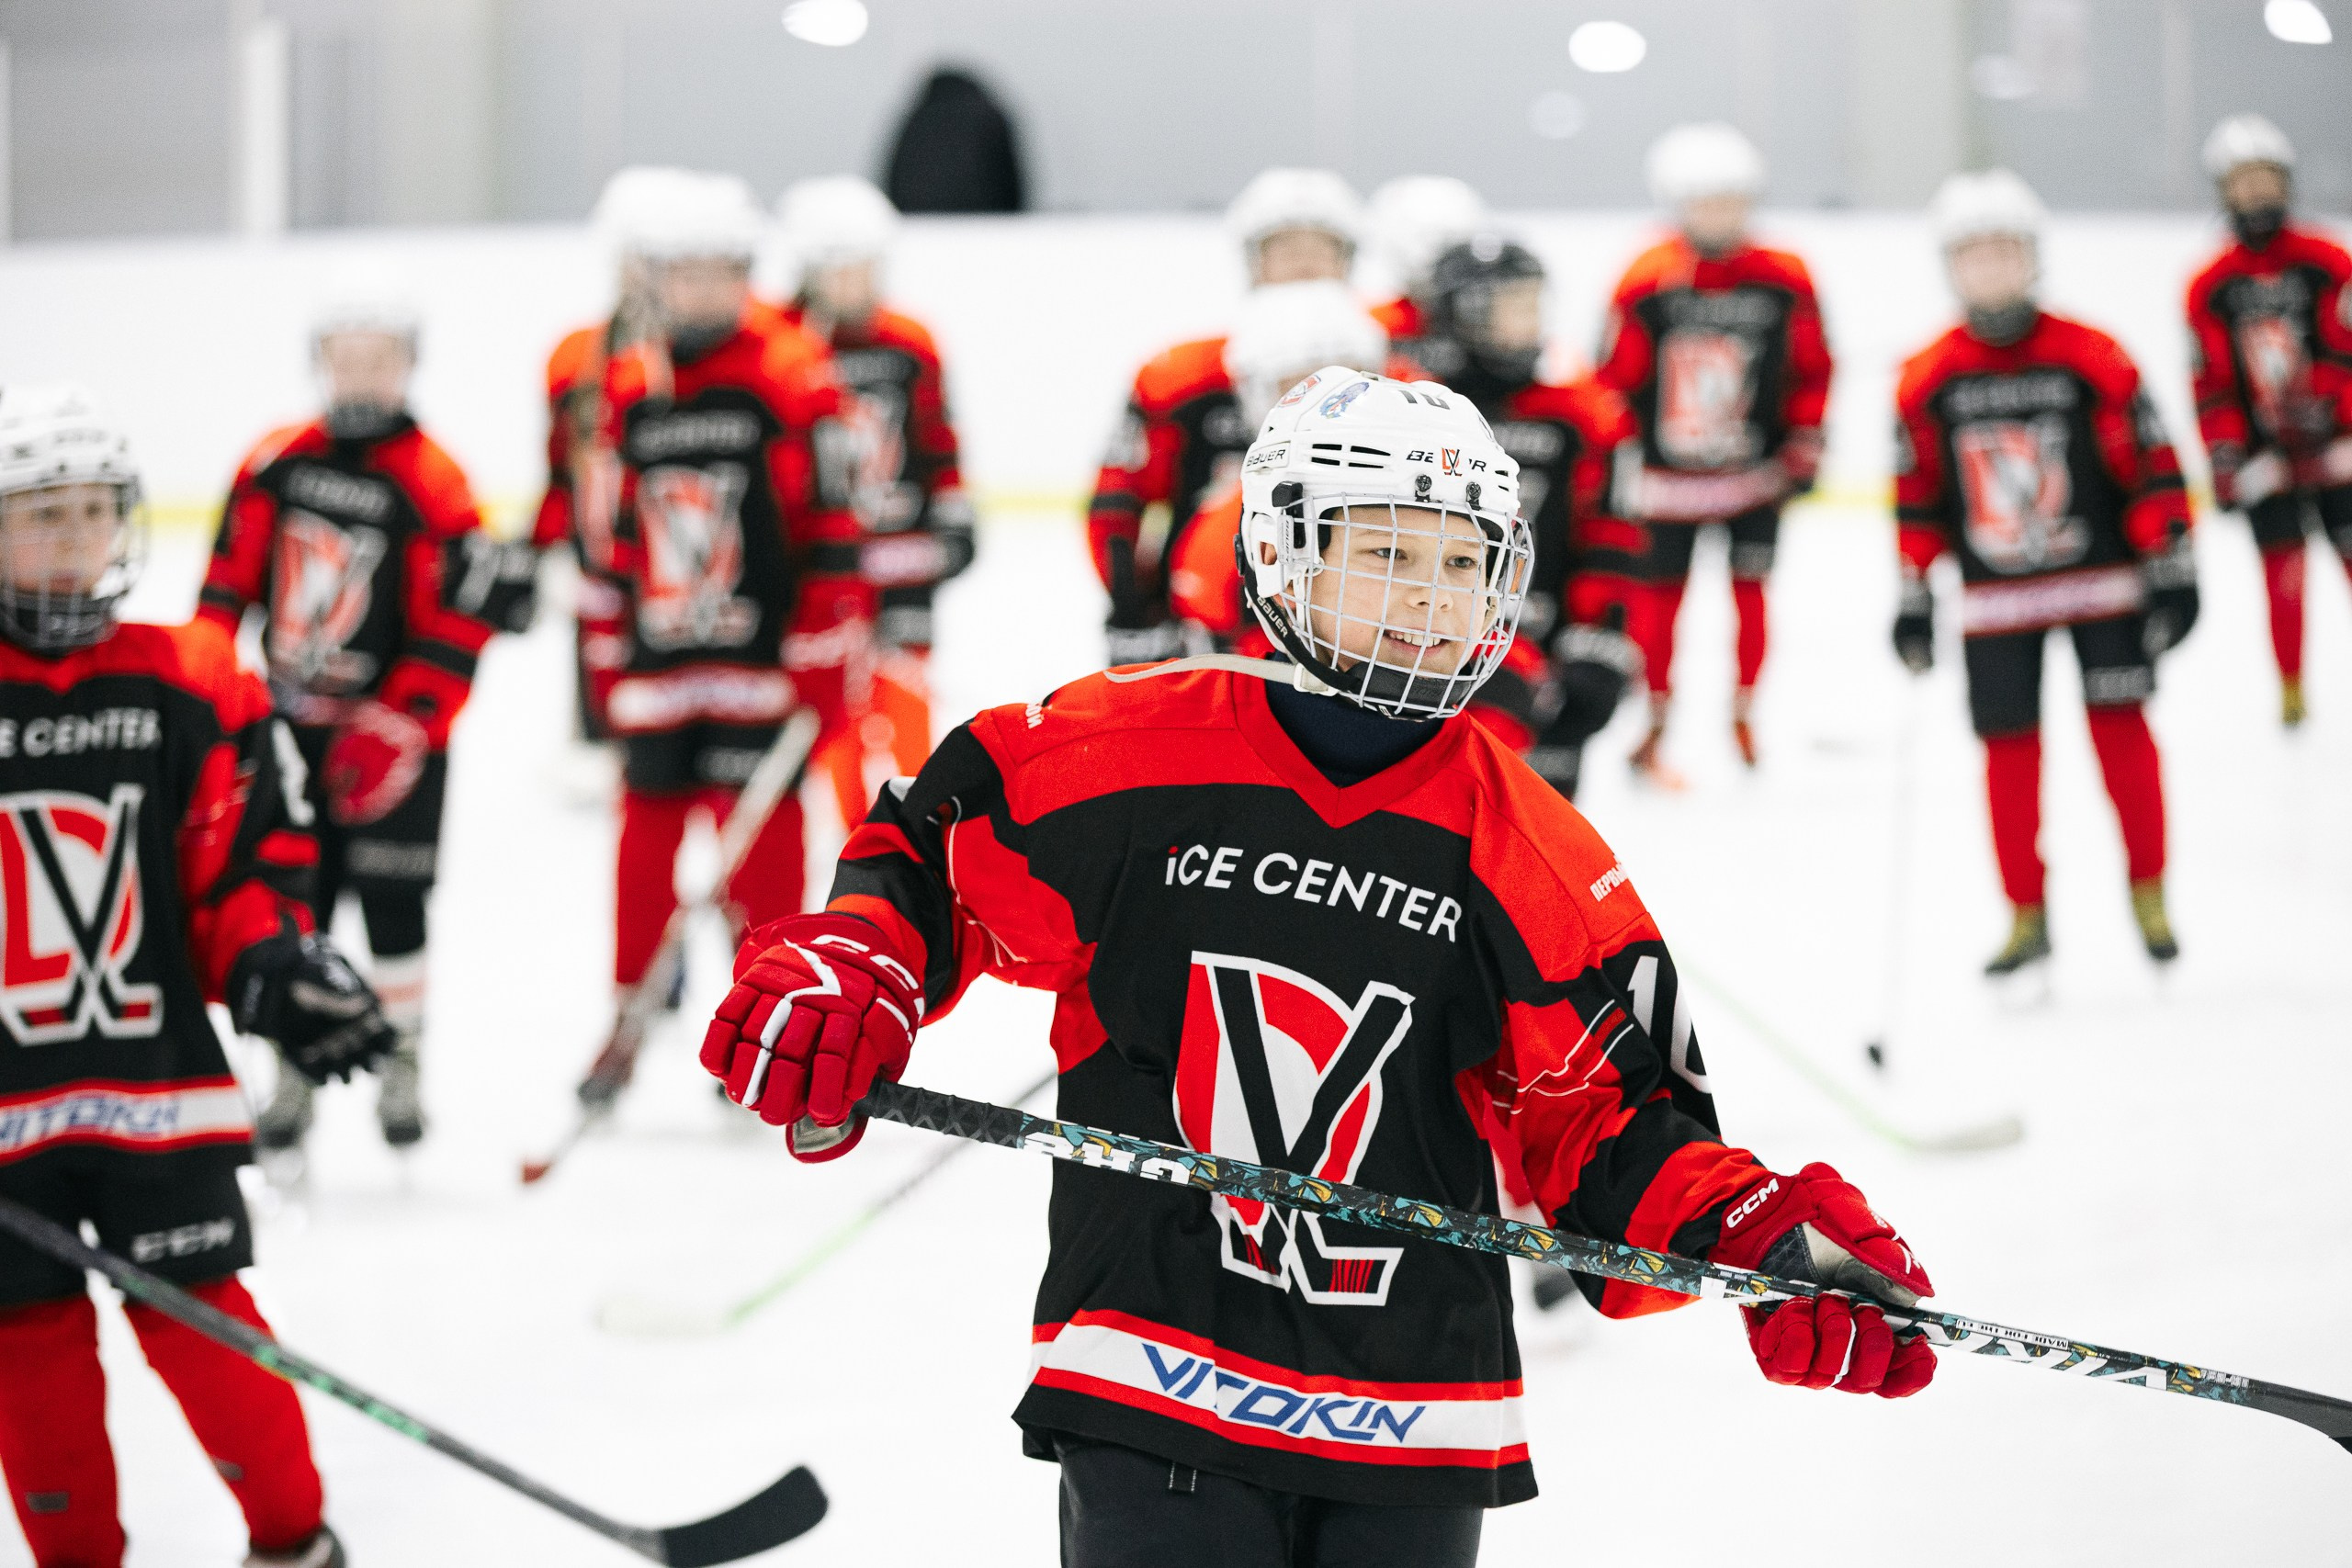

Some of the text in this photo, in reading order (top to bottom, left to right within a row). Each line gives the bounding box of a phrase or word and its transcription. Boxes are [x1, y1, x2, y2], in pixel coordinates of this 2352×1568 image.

[1247, 449, 1286, 467] BAUER
[1256, 596, 1288, 637] BAUER
[22, 706, 164, 759] CENTER
[1253, 852, 1463, 942] CENTER
[1725, 1178, 1780, 1229] CCM
[1140, 1343, 1426, 1444] VITOKIN
